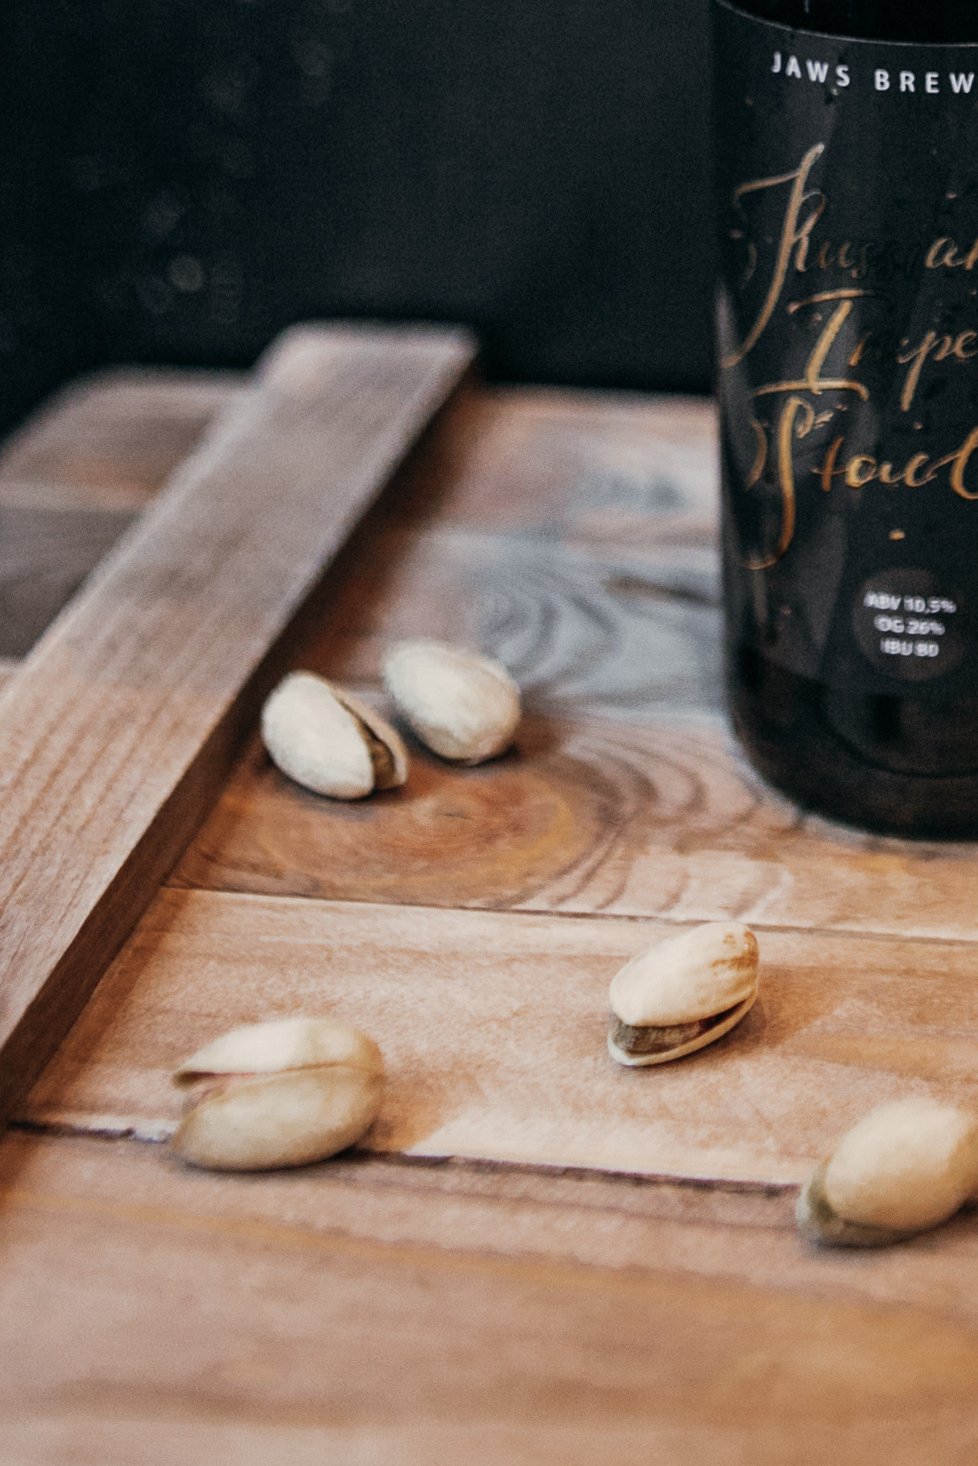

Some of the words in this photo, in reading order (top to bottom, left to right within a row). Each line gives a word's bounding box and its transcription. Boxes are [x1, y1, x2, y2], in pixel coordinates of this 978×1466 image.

[771, 51, 851, 88] JAWS
[863, 590, 901, 610] ABV
[880, 637, 913, 656] IBU
